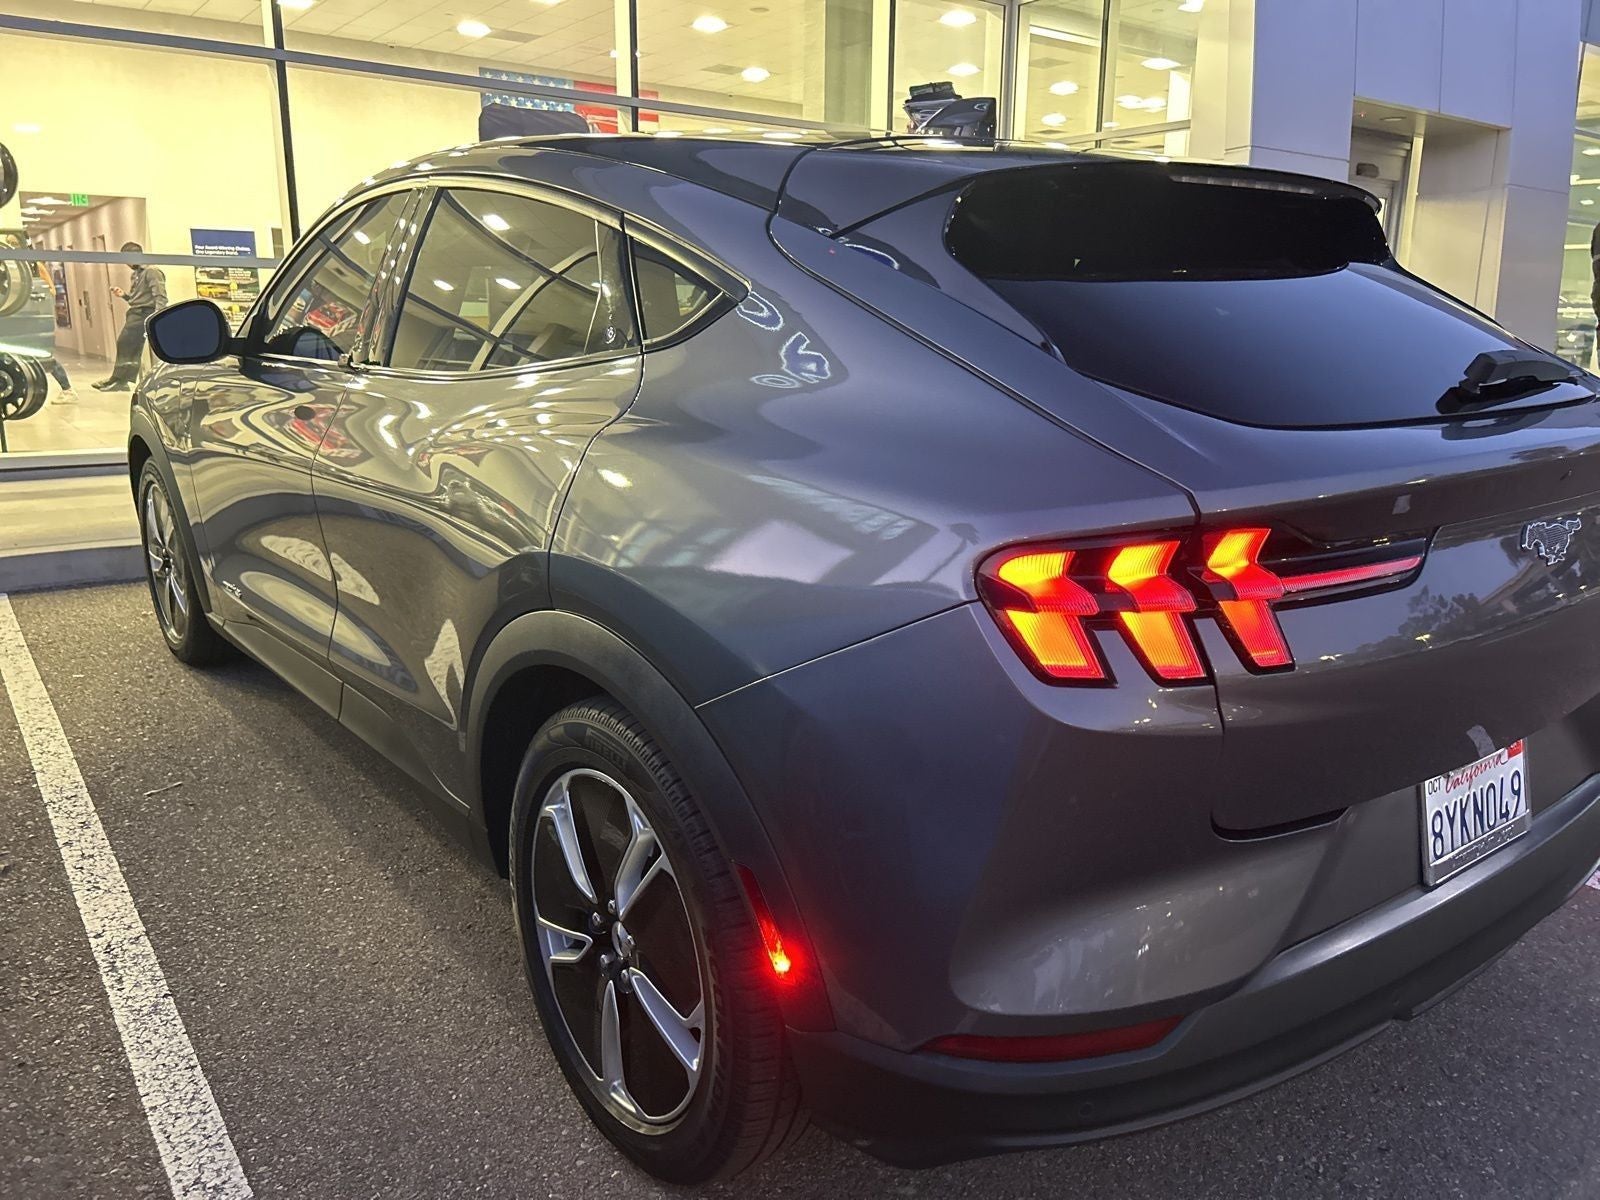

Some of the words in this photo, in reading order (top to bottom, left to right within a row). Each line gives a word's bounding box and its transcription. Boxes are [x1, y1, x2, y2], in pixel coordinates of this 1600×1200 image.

[1428, 777, 1442, 795] OCT
[1445, 753, 1508, 794] California
[1431, 769, 1522, 859] 8YKN049
